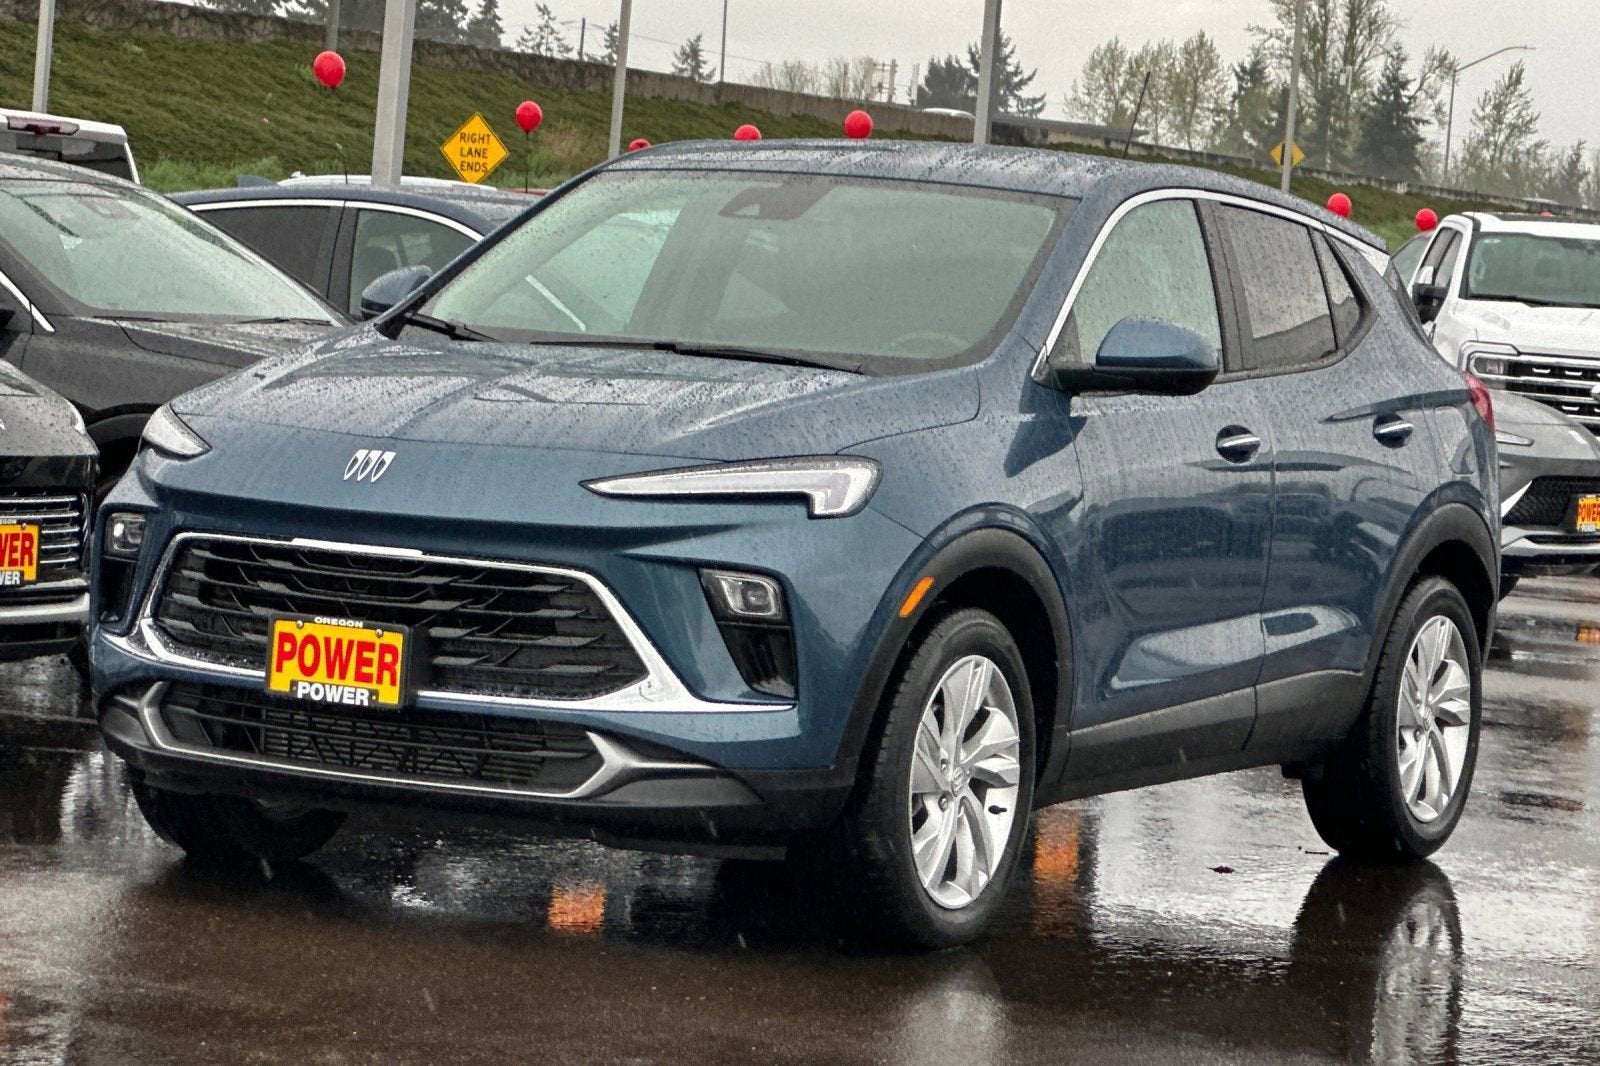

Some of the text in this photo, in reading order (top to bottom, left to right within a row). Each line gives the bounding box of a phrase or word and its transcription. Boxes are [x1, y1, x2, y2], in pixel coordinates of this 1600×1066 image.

[459, 132, 491, 144] RIGHT
[459, 146, 489, 159] LANE
[459, 160, 489, 173] ENDS
[313, 616, 364, 628] OREGON
[275, 631, 399, 687] POWER
[296, 681, 370, 706] POWER
